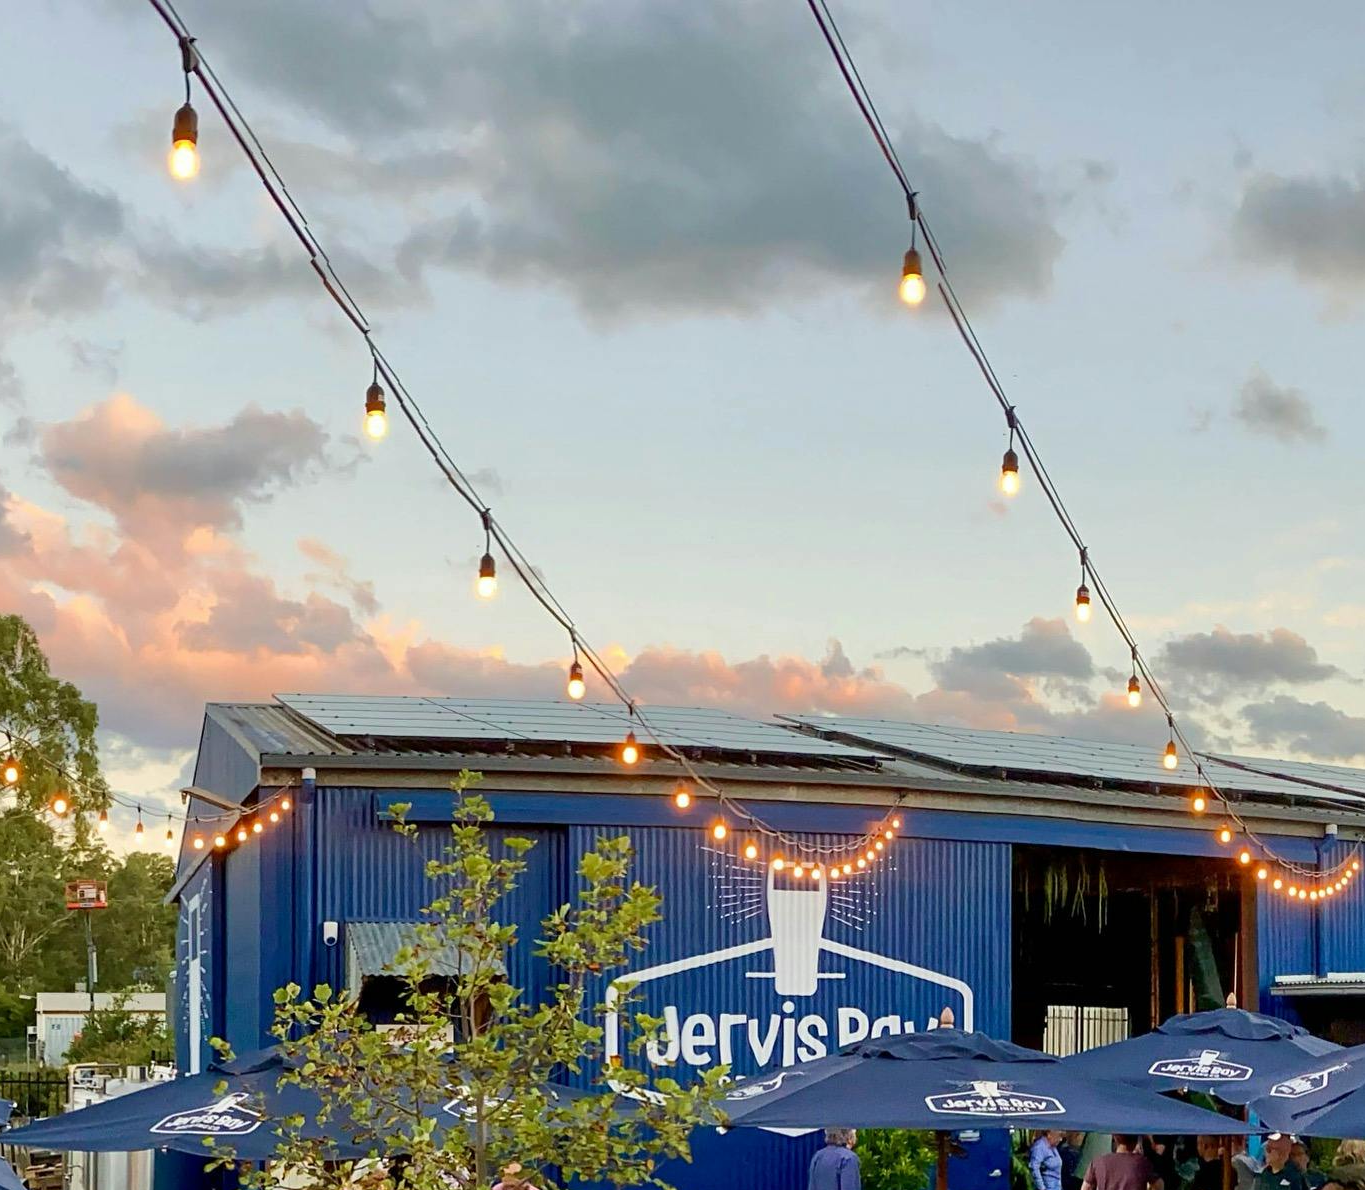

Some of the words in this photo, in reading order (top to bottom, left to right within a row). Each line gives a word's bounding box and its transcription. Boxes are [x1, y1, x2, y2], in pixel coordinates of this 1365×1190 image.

[646, 1000, 828, 1068] Jervis
[1161, 1063, 1210, 1073] Jervis
[1211, 1066, 1241, 1077] Bay
[943, 1097, 1010, 1108] Jervis
[1010, 1098, 1046, 1110] Bay
